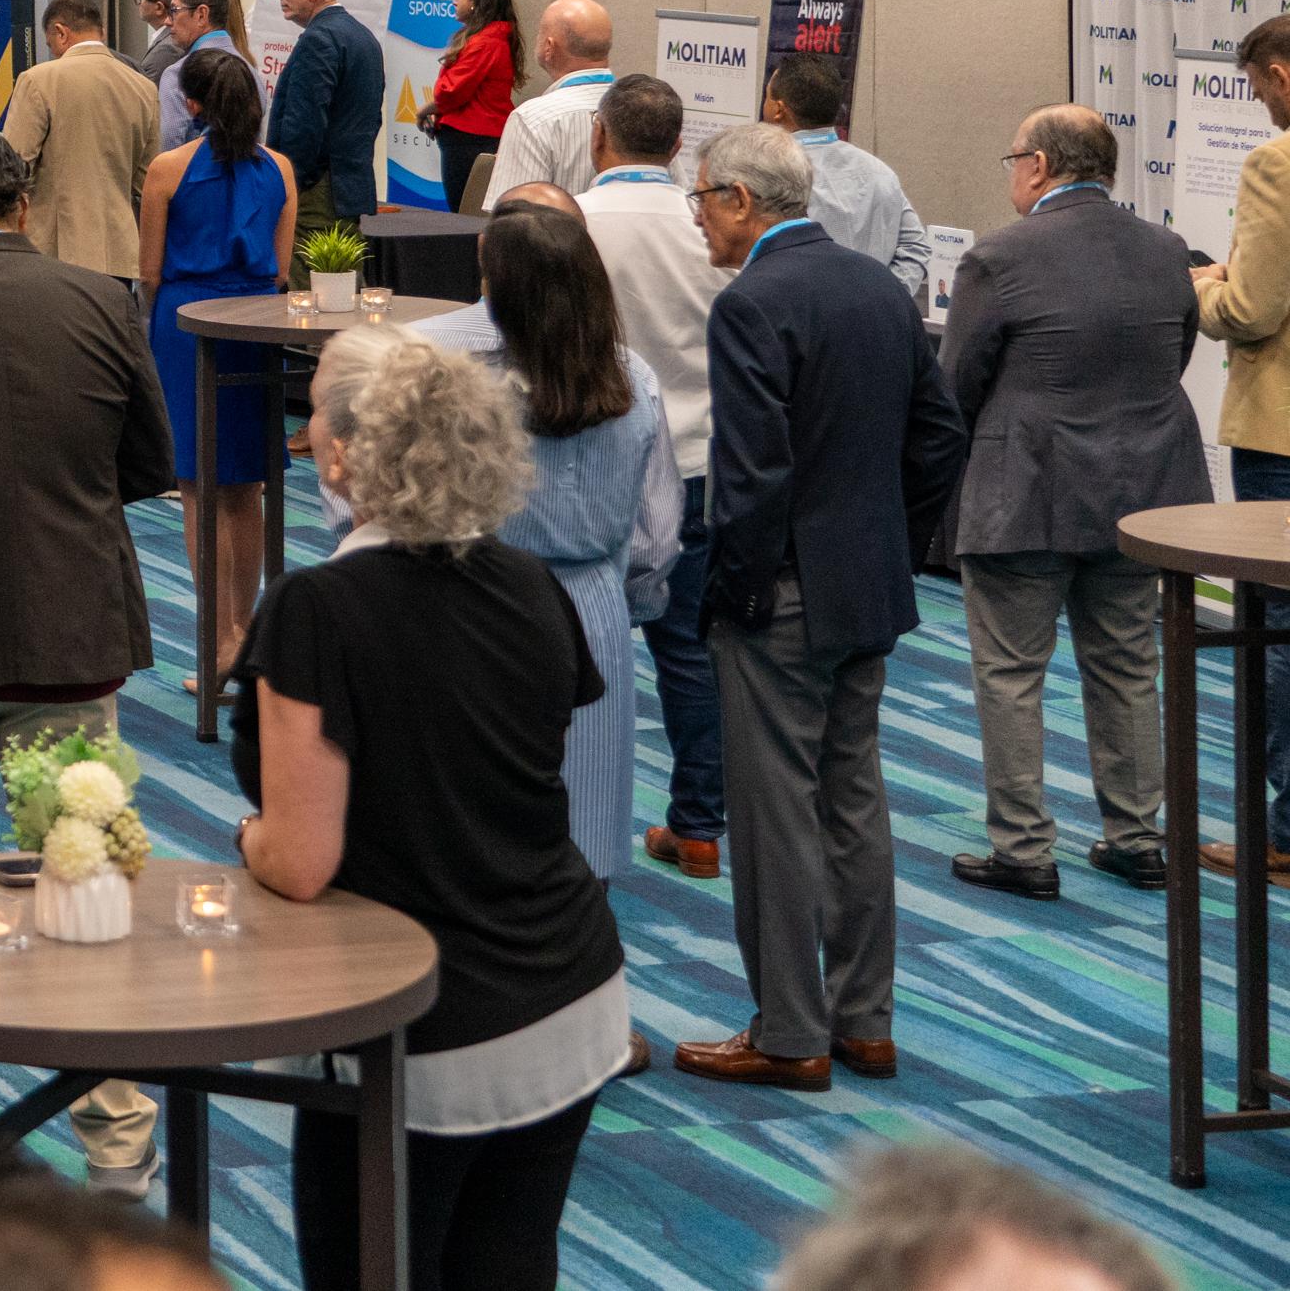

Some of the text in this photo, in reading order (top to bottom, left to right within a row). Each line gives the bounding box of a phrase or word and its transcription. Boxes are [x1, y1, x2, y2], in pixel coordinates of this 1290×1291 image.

[408, 1, 457, 18] SPONSO
[794, 15, 842, 54] alert
[264, 42, 293, 53] protekt
[666, 40, 746, 68] MOLITIAM
